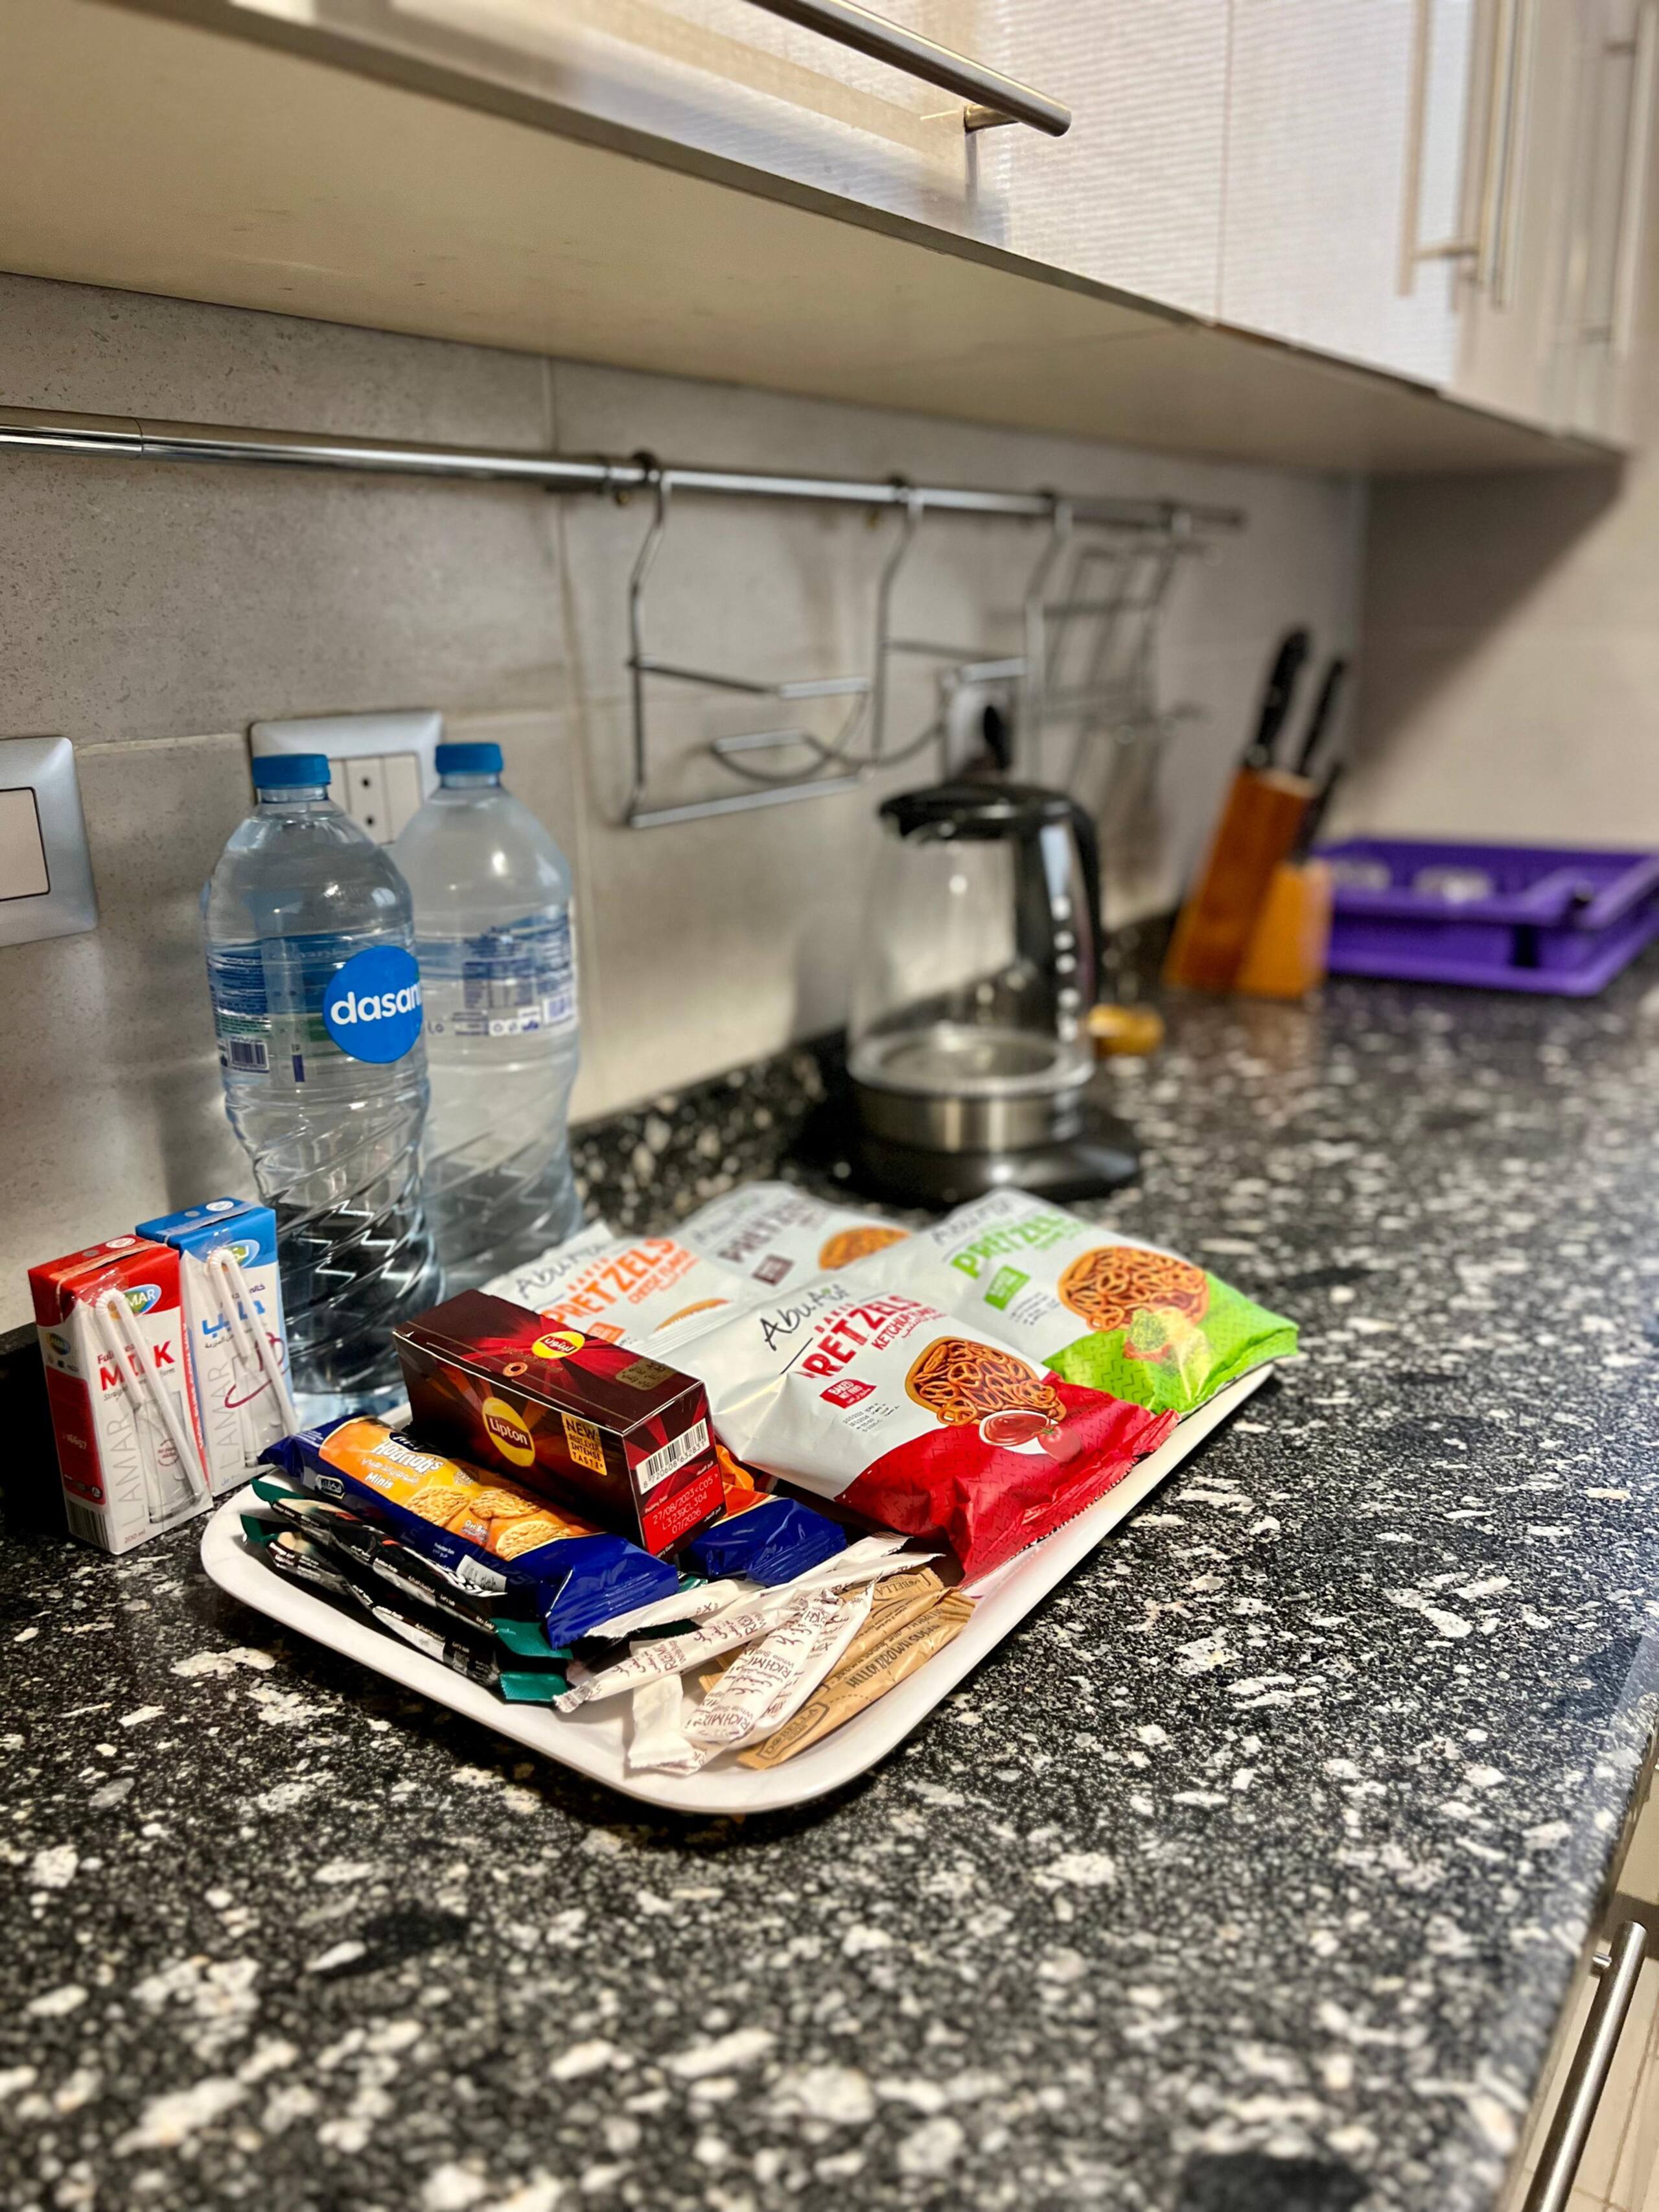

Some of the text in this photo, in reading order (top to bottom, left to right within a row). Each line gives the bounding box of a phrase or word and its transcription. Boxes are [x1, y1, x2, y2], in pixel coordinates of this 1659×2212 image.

[331, 981, 422, 1025] dasan
[795, 1295, 922, 1379] RETZELS
[489, 1417, 529, 1446] Lipton
[565, 1417, 597, 1441] NEW
[571, 1442, 603, 1462] INTENSE
[364, 1471, 395, 1489] Minis
[671, 1508, 702, 1534] 07/2026
[748, 1656, 793, 1679] RICHMI
[879, 1639, 911, 1670] BROWN
